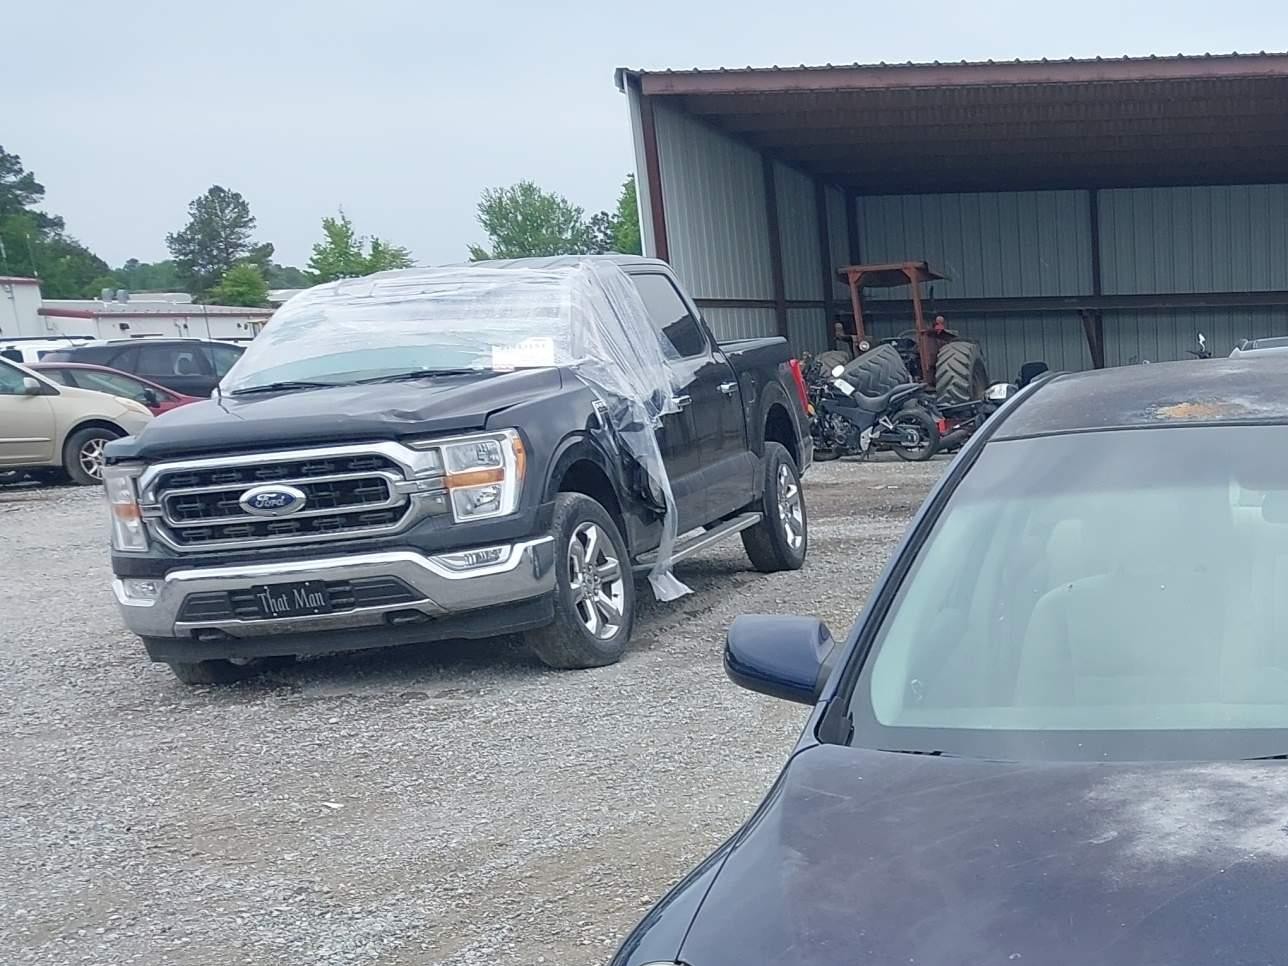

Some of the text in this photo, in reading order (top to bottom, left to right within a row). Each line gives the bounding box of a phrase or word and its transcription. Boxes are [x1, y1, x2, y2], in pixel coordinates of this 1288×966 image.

[255, 493, 286, 508] Ford
[256, 587, 326, 614] That Man
